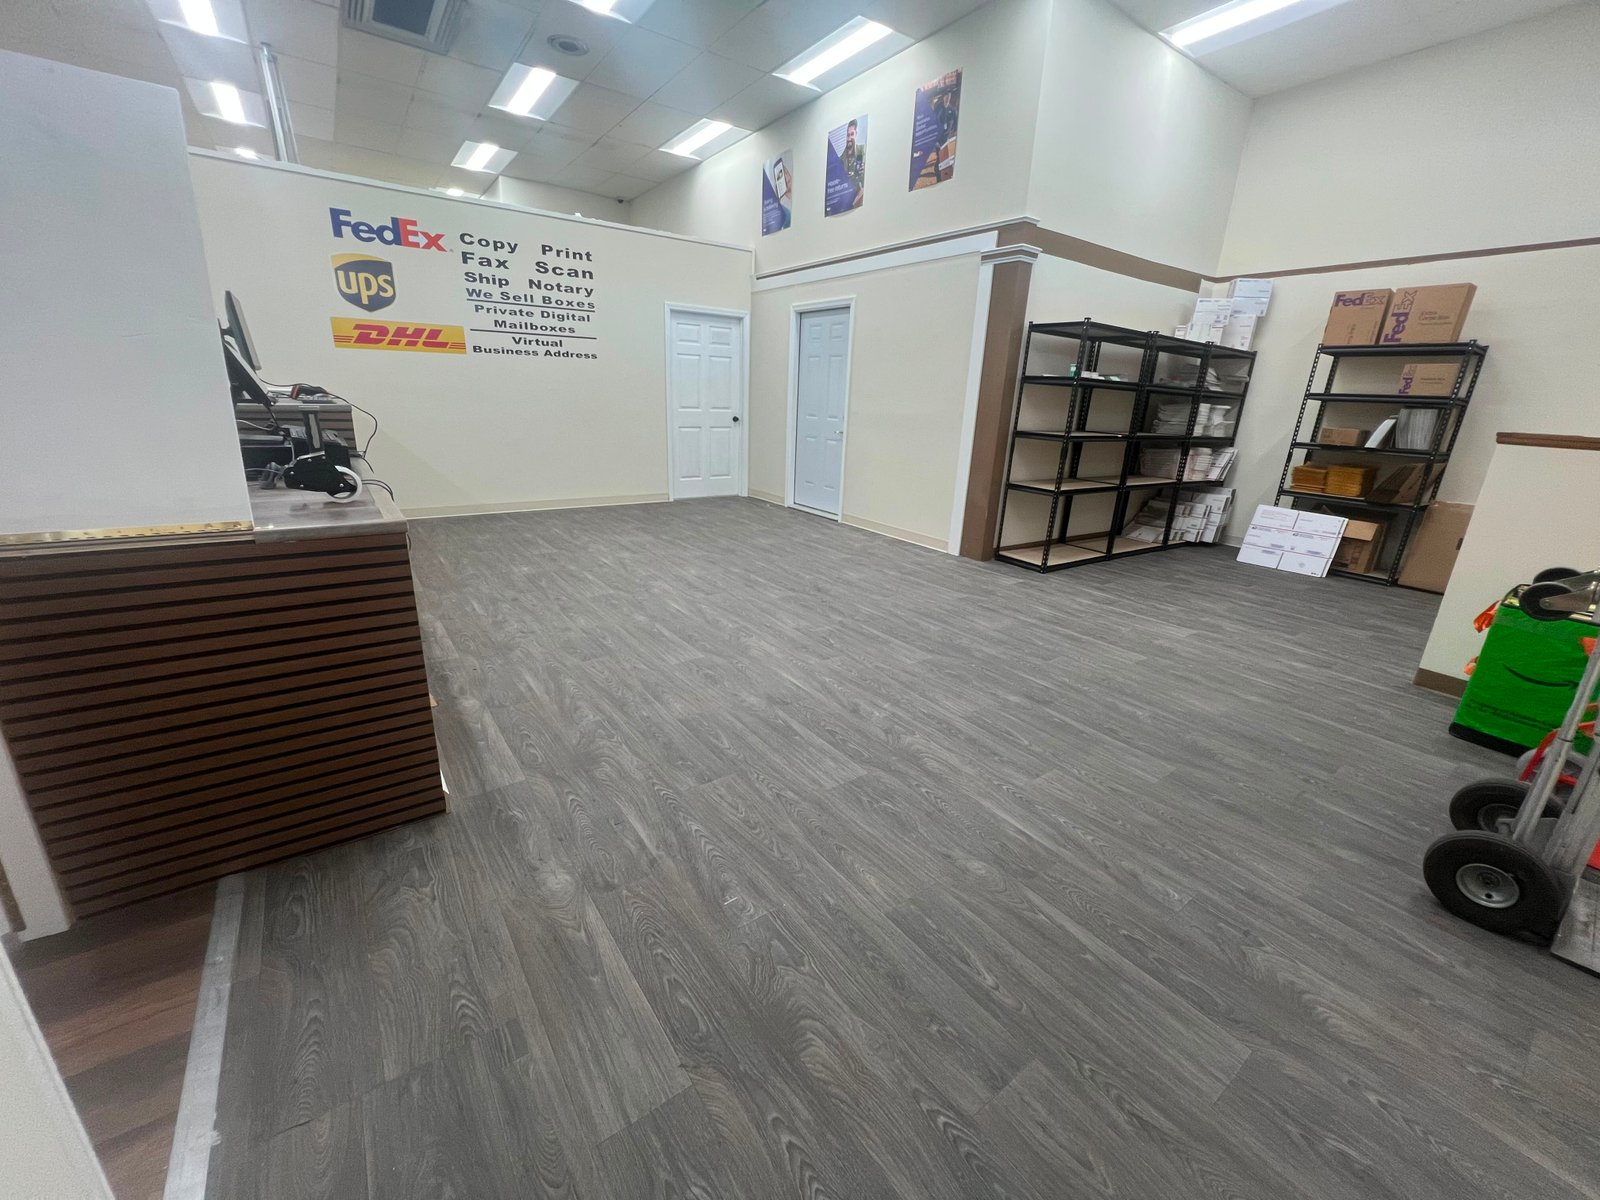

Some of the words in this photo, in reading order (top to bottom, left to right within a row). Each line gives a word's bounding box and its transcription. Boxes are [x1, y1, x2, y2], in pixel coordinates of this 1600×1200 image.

[329, 207, 448, 252] FedEx
[459, 232, 518, 254] Copy
[541, 244, 593, 262] Print
[461, 251, 509, 270] Fax
[535, 261, 594, 280] Scan
[337, 270, 394, 304] ups
[464, 271, 510, 288] Ship
[528, 278, 594, 298] Notary
[466, 287, 493, 299] We
[500, 291, 534, 304] Sell
[542, 295, 596, 310] Boxes
[1334, 293, 1386, 307] FedEx
[474, 304, 535, 318] Private
[540, 310, 590, 323] Digital
[1383, 290, 1418, 343] FedEx
[352, 323, 449, 349] DHL
[494, 320, 576, 334] Mailboxes
[473, 345, 539, 357] Business
[543, 349, 598, 360] Address
[512, 336, 563, 348] Virtual
